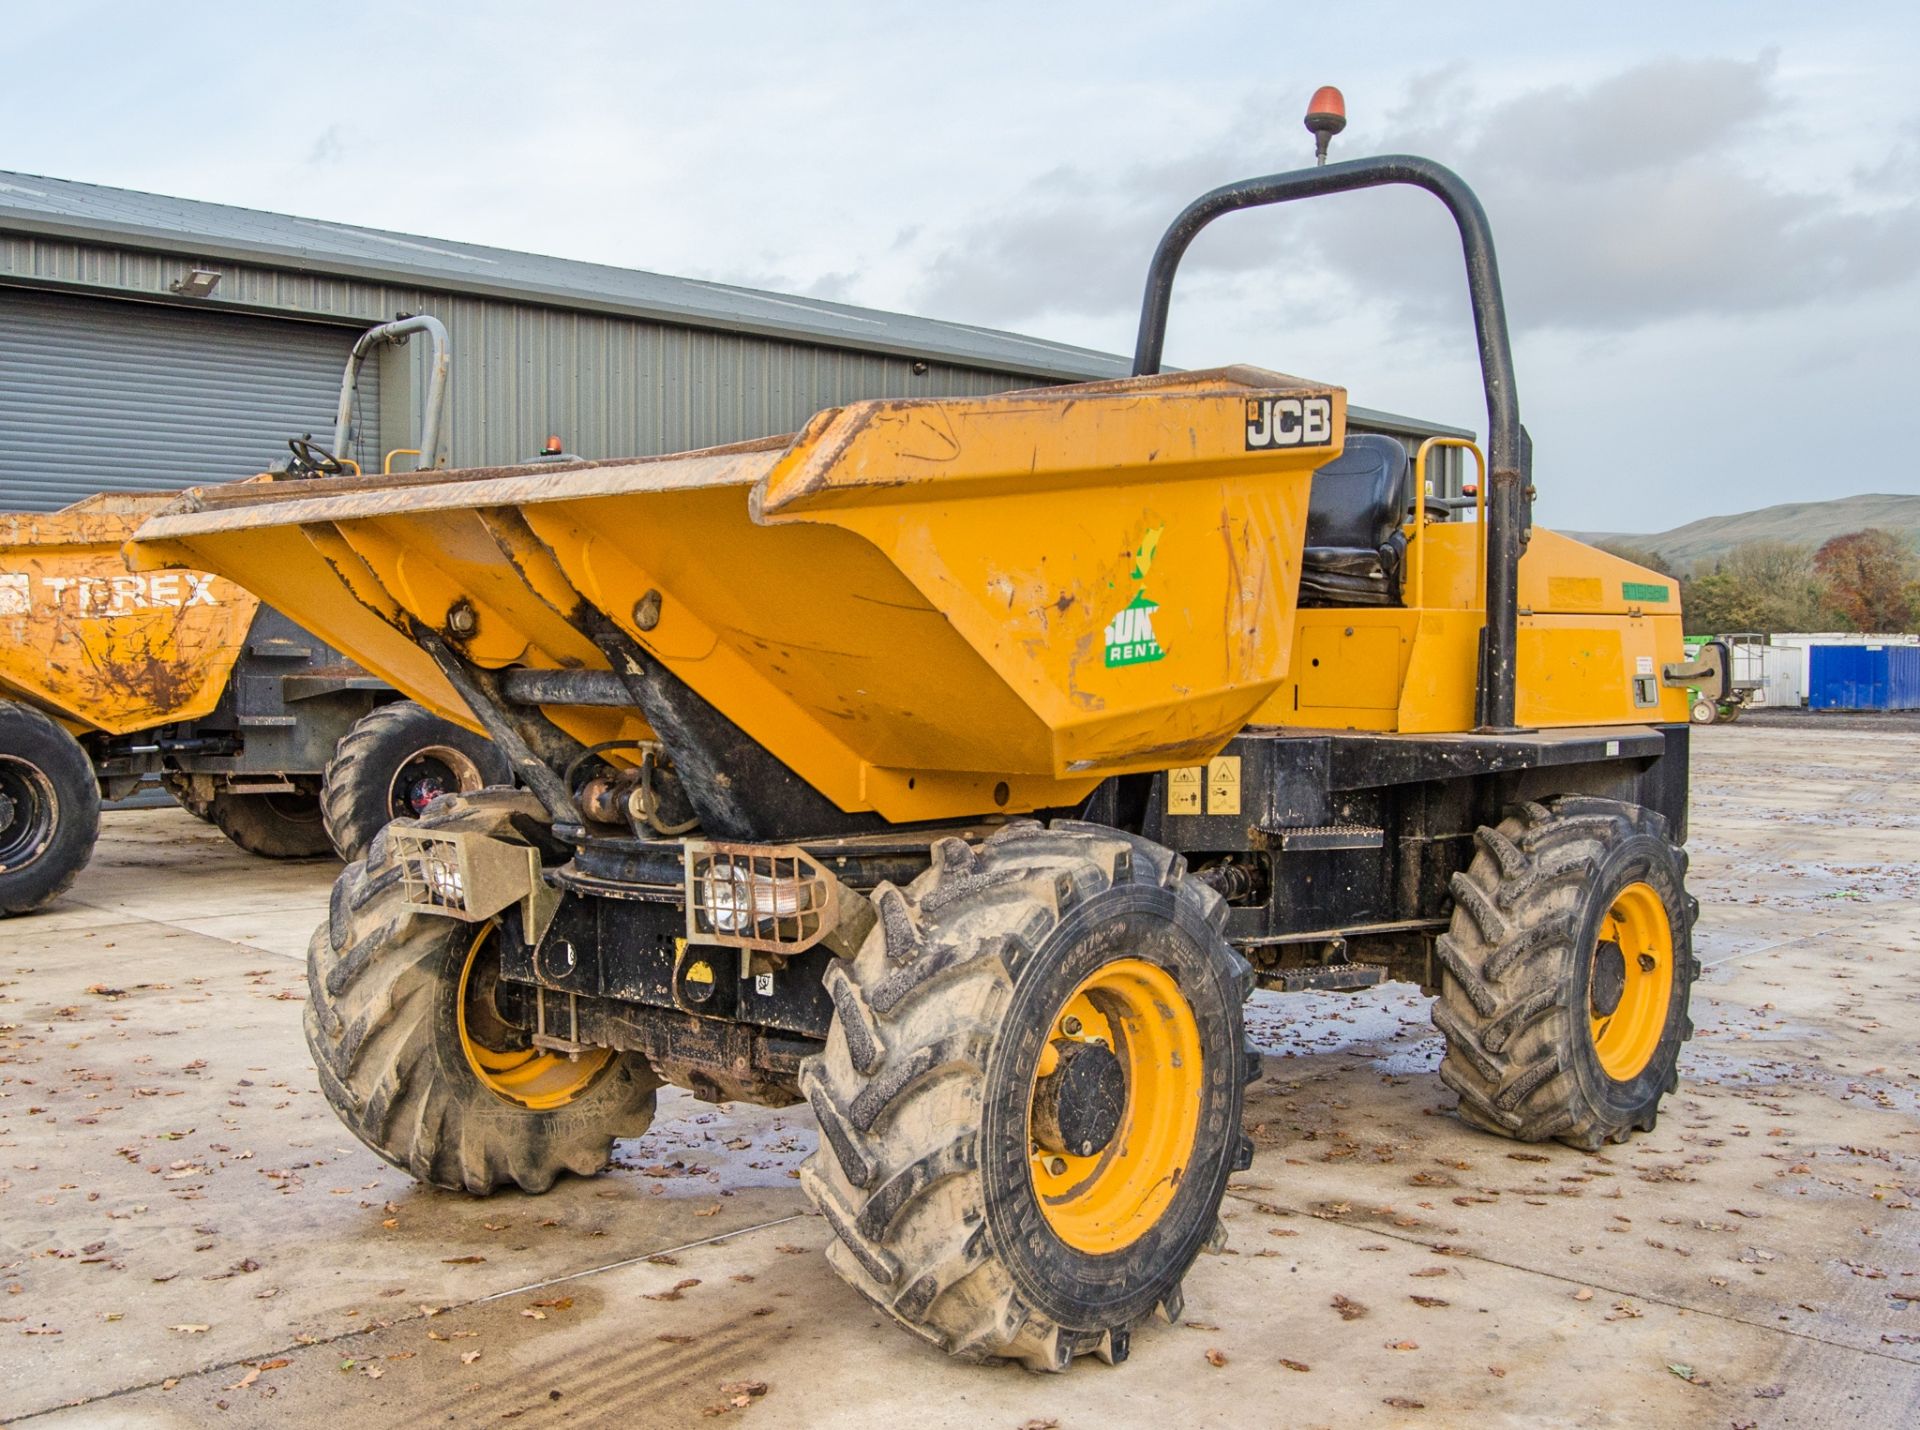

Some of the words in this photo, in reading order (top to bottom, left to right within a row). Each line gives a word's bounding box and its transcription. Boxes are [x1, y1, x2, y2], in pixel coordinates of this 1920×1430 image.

[1247, 398, 1331, 447] JCB
[42, 573, 219, 616] TEREX
[1110, 642, 1164, 661] RENT
